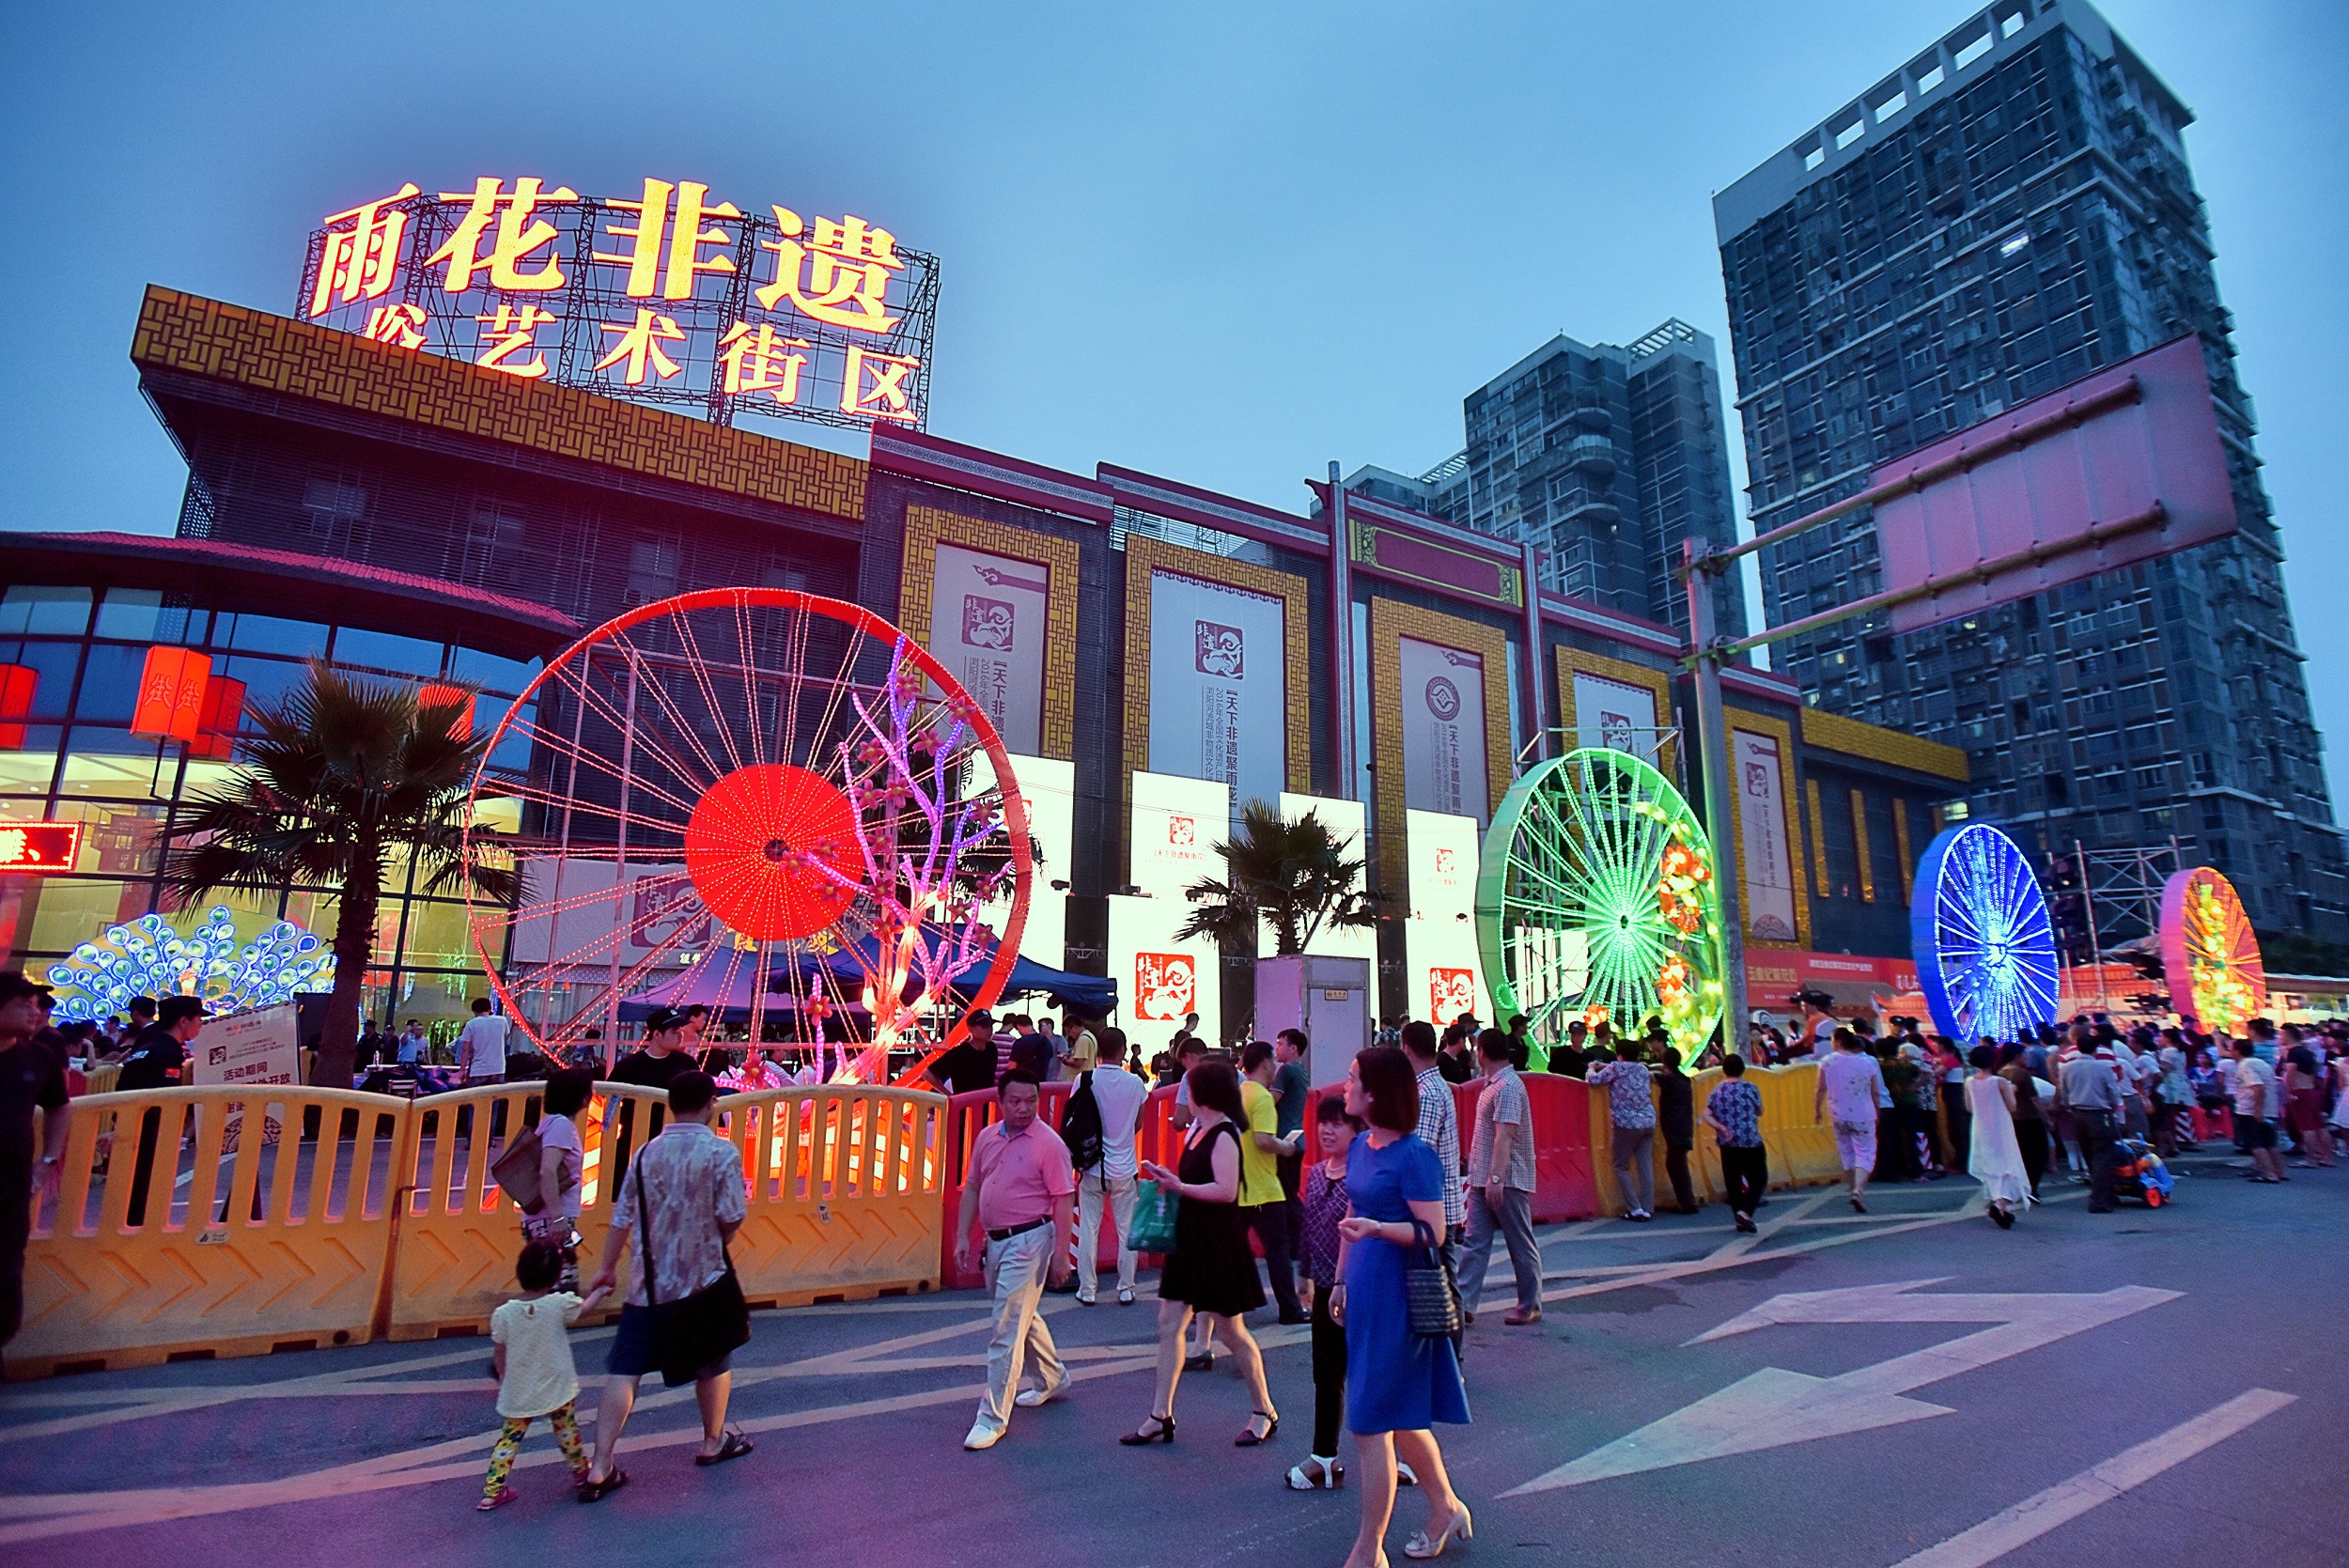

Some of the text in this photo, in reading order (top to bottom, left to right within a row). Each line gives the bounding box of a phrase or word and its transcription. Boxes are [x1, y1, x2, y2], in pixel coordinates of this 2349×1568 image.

[310, 176, 905, 334] 雨花非遗
[1215, 687, 1223, 783] 2016年全国文化遗产日
[224, 1061, 268, 1081] 活动期间
